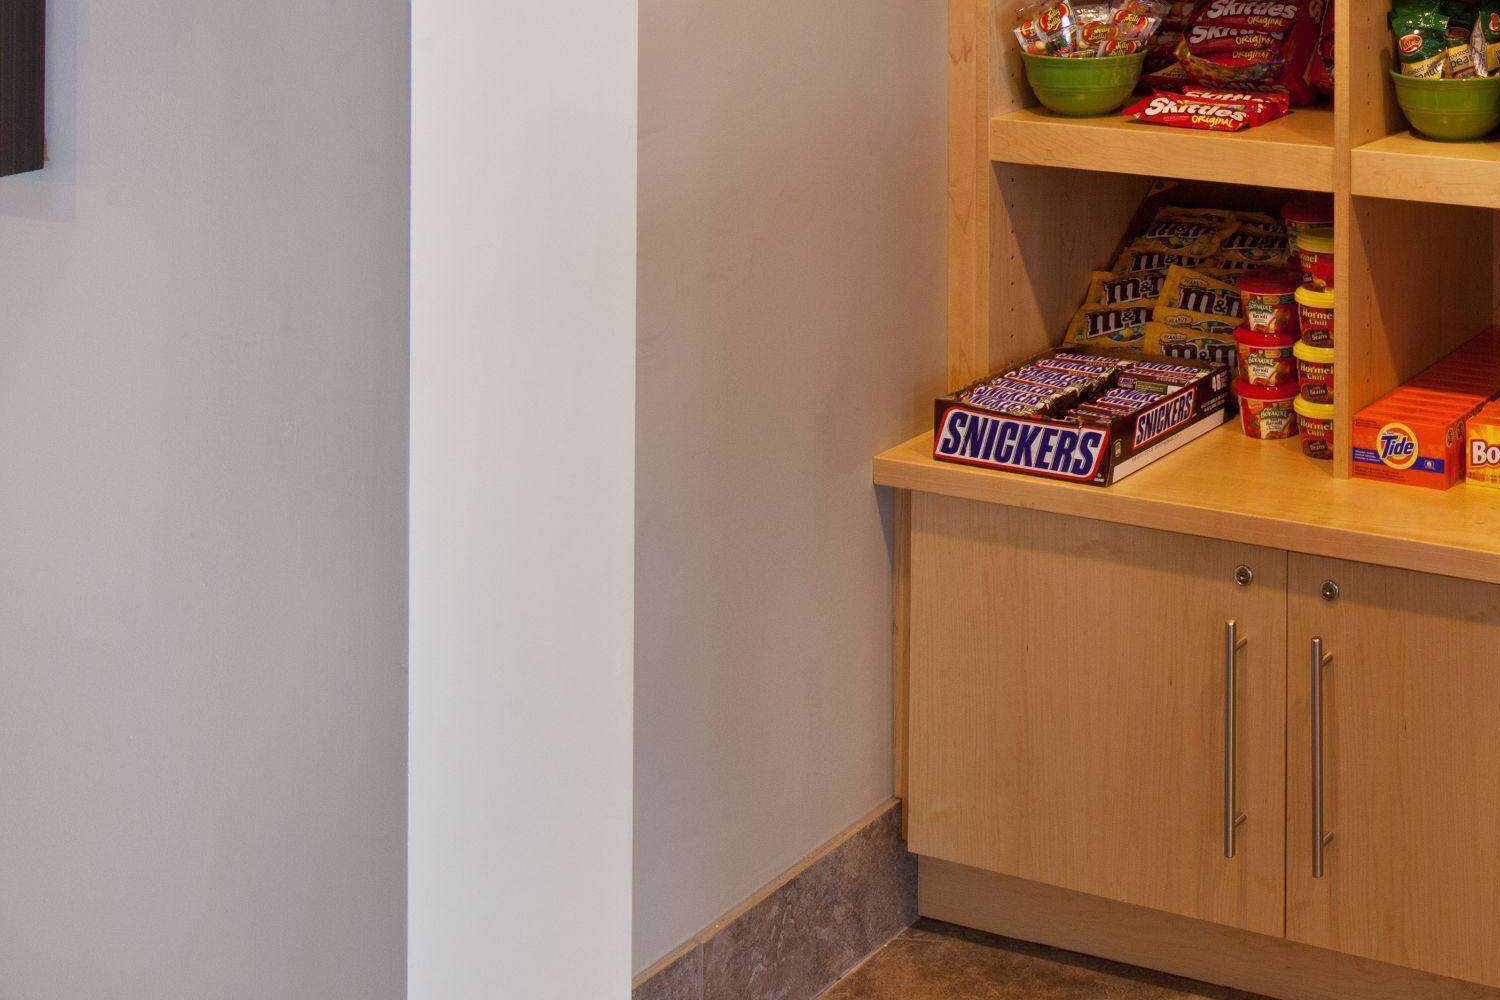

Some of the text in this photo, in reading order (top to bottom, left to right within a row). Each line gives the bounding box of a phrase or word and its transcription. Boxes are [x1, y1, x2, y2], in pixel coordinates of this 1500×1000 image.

[1207, 0, 1298, 19] Skittles
[1144, 97, 1249, 122] Skittles
[1300, 363, 1333, 375] Hormel
[1136, 390, 1193, 446] SNICKERS
[1300, 418, 1333, 431] Hormel
[940, 411, 1103, 476] SNICKERS
[1381, 435, 1415, 460] Tide
